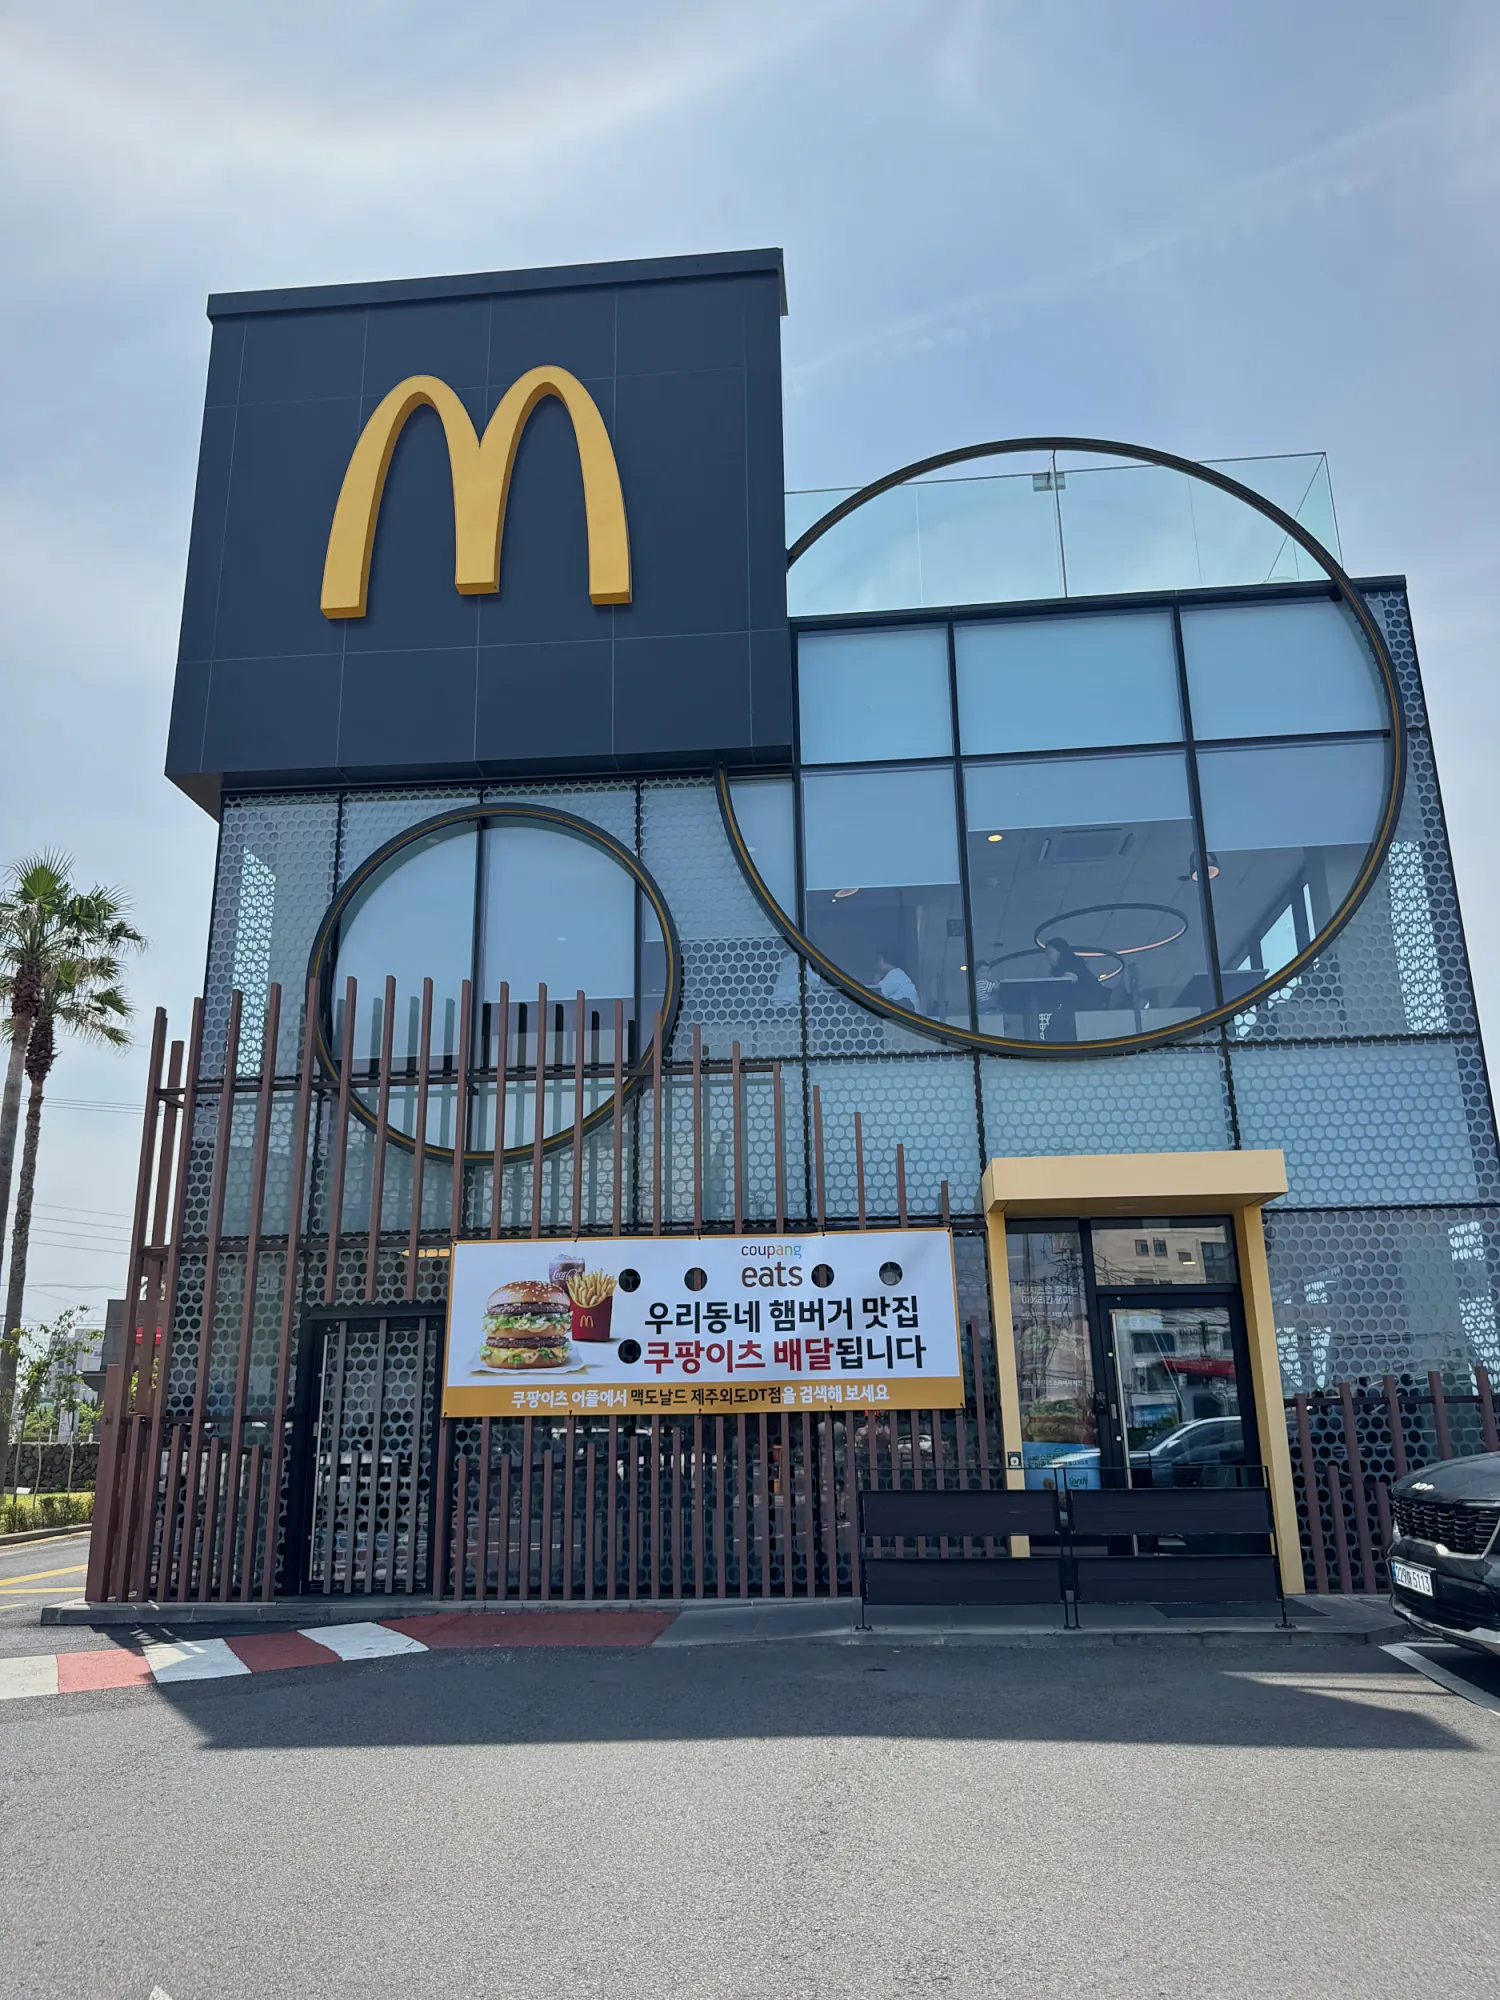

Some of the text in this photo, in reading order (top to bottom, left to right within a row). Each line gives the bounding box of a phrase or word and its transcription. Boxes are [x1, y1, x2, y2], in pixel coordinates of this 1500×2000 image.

[740, 1244, 803, 1259] coupang
[740, 1261, 804, 1288] eats
[644, 1295, 920, 1335] 우리동네 햄버거 맛집
[643, 1335, 927, 1375] 쿠팡이츠 배달됩니다
[511, 1384, 891, 1409] 쿠팡이츠 어플에서 맥도날드 제주외도DT점을 검색해 보세요
